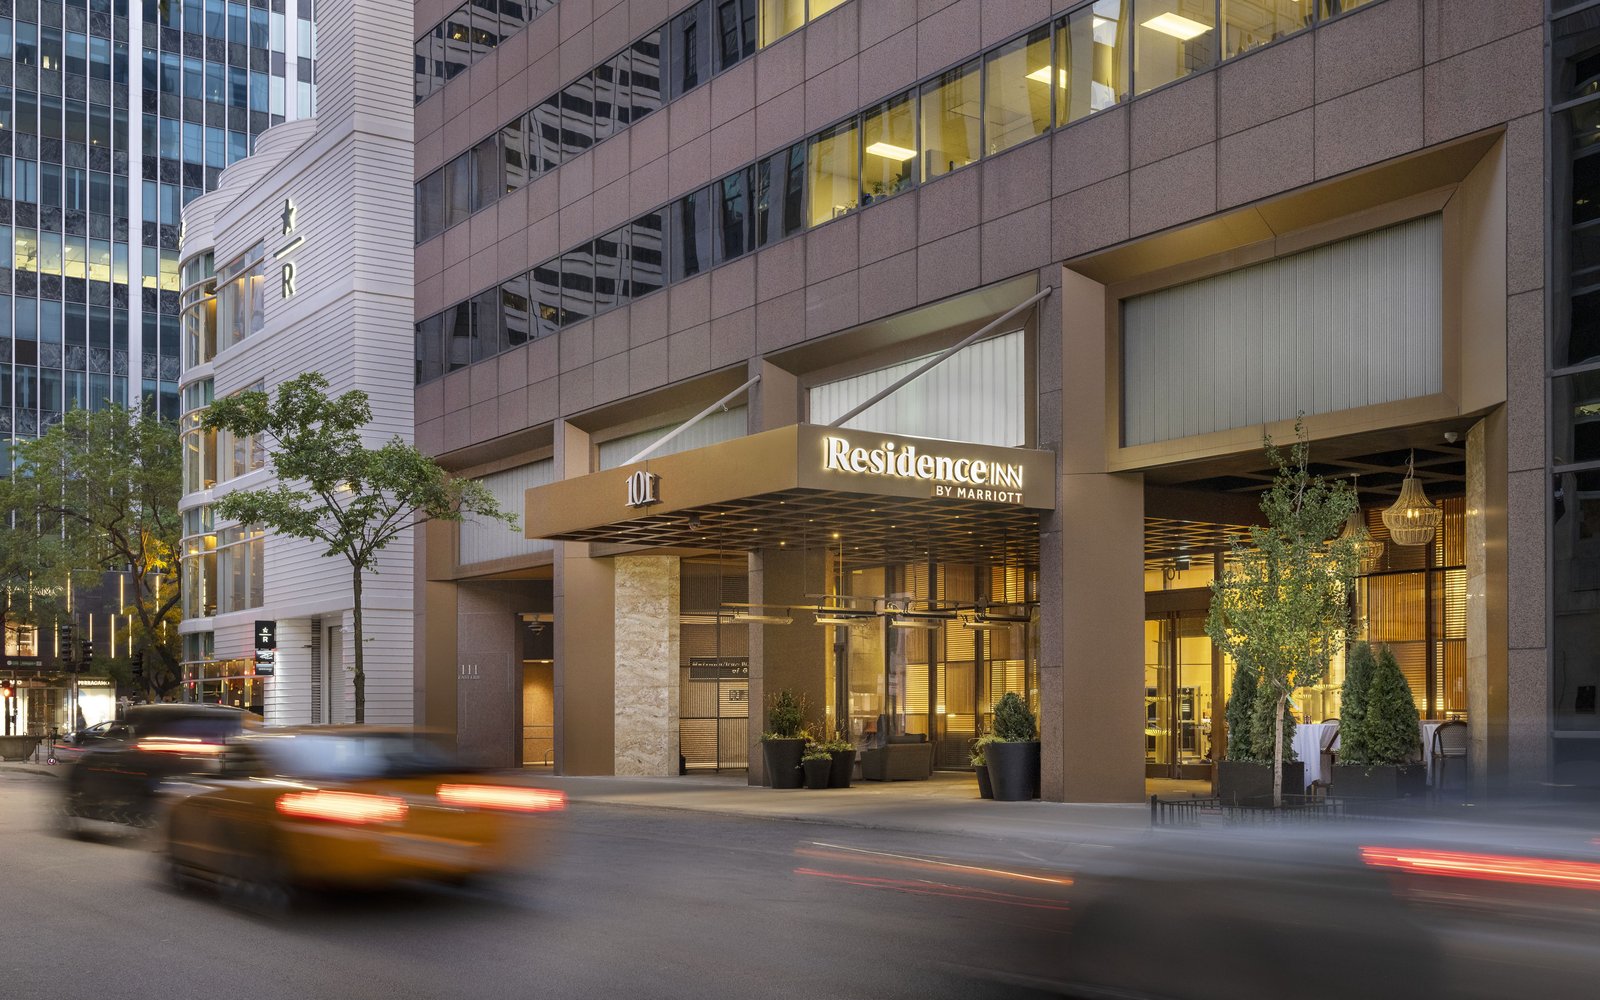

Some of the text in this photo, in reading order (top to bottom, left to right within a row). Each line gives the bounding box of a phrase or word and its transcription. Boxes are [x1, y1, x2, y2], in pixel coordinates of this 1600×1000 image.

[281, 262, 297, 299] R
[827, 436, 1024, 489] Residence INN
[624, 470, 657, 507] 101
[936, 485, 1024, 504] BY MARRIOTT
[461, 664, 478, 675] 111
